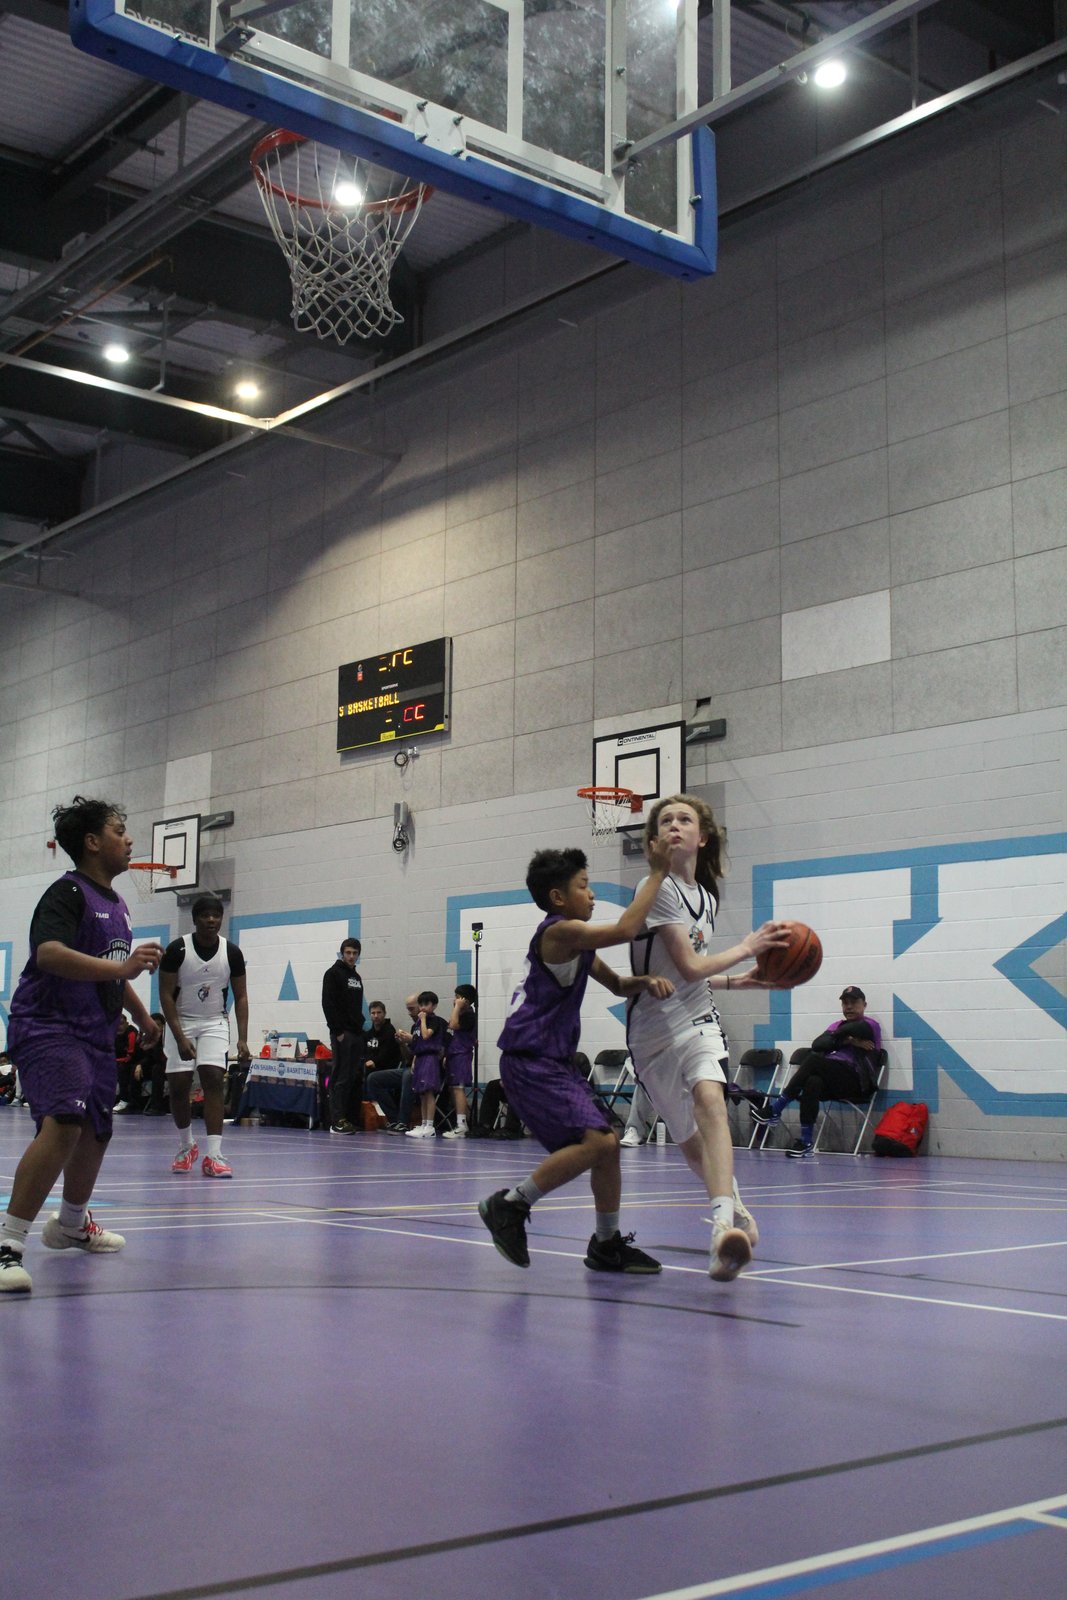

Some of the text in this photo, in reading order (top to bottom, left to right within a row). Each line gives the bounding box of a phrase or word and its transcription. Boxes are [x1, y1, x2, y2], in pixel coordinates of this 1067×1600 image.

[347, 692, 400, 716] BASKETBALL
[617, 733, 655, 746] CONTINENTAL
[102, 949, 130, 961] MAMB
[260, 1064, 277, 1072] SHARKS
[286, 1066, 317, 1076] BASKETBALL
